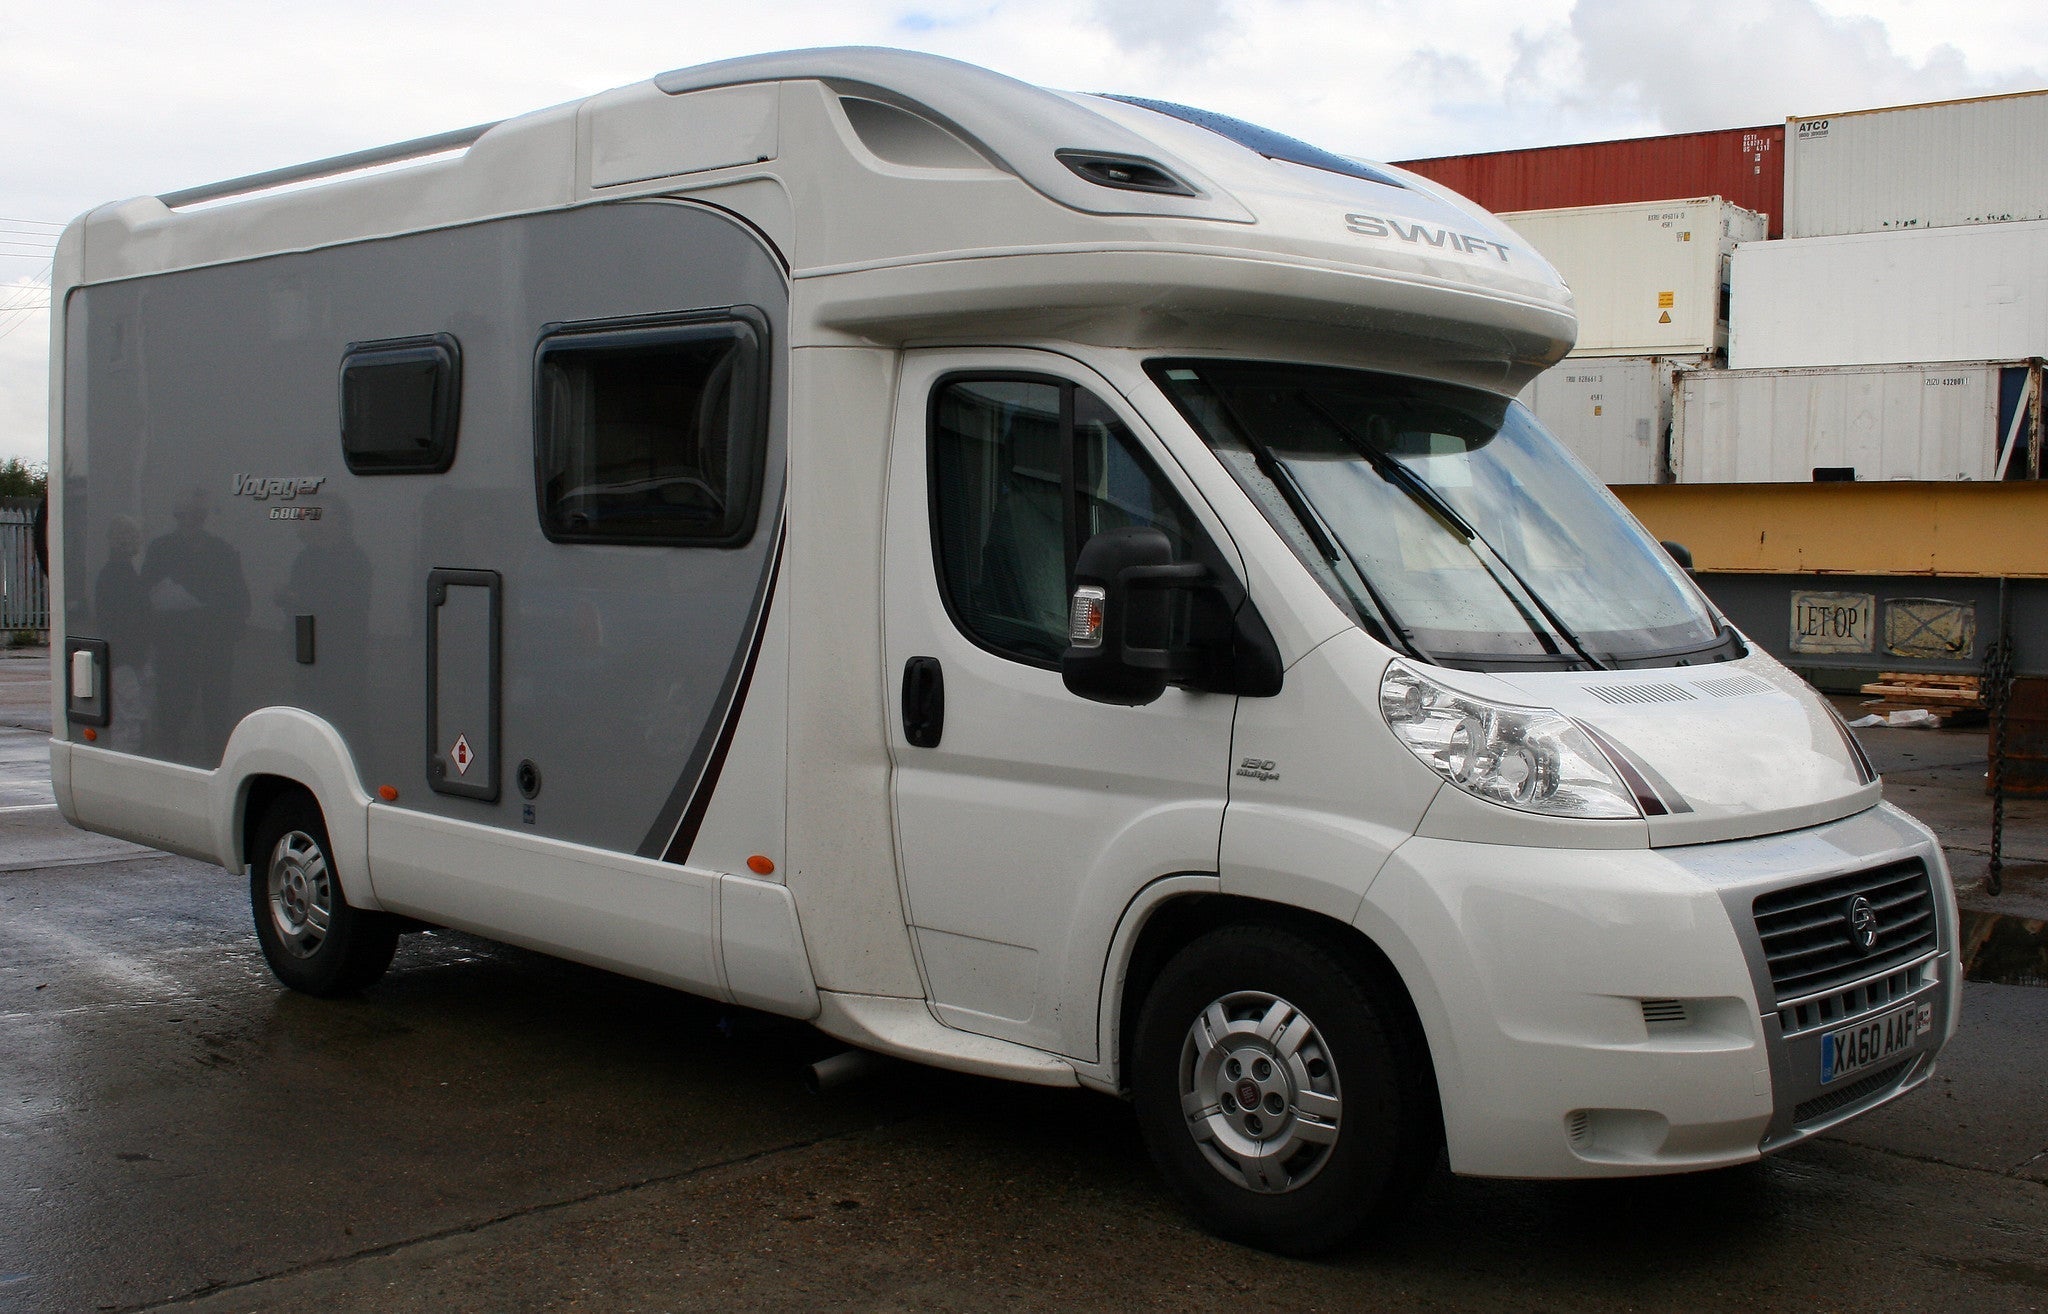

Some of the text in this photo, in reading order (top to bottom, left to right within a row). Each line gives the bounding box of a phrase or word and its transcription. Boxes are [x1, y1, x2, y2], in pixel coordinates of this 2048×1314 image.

[1799, 120, 1829, 132] ATCO
[1344, 213, 1510, 263] SWIFT
[233, 473, 326, 500] Voyager
[1797, 605, 1829, 636] LET
[1834, 607, 1857, 638] OP
[1835, 1023, 1880, 1074] XA60
[1885, 1009, 1913, 1054] AAF
